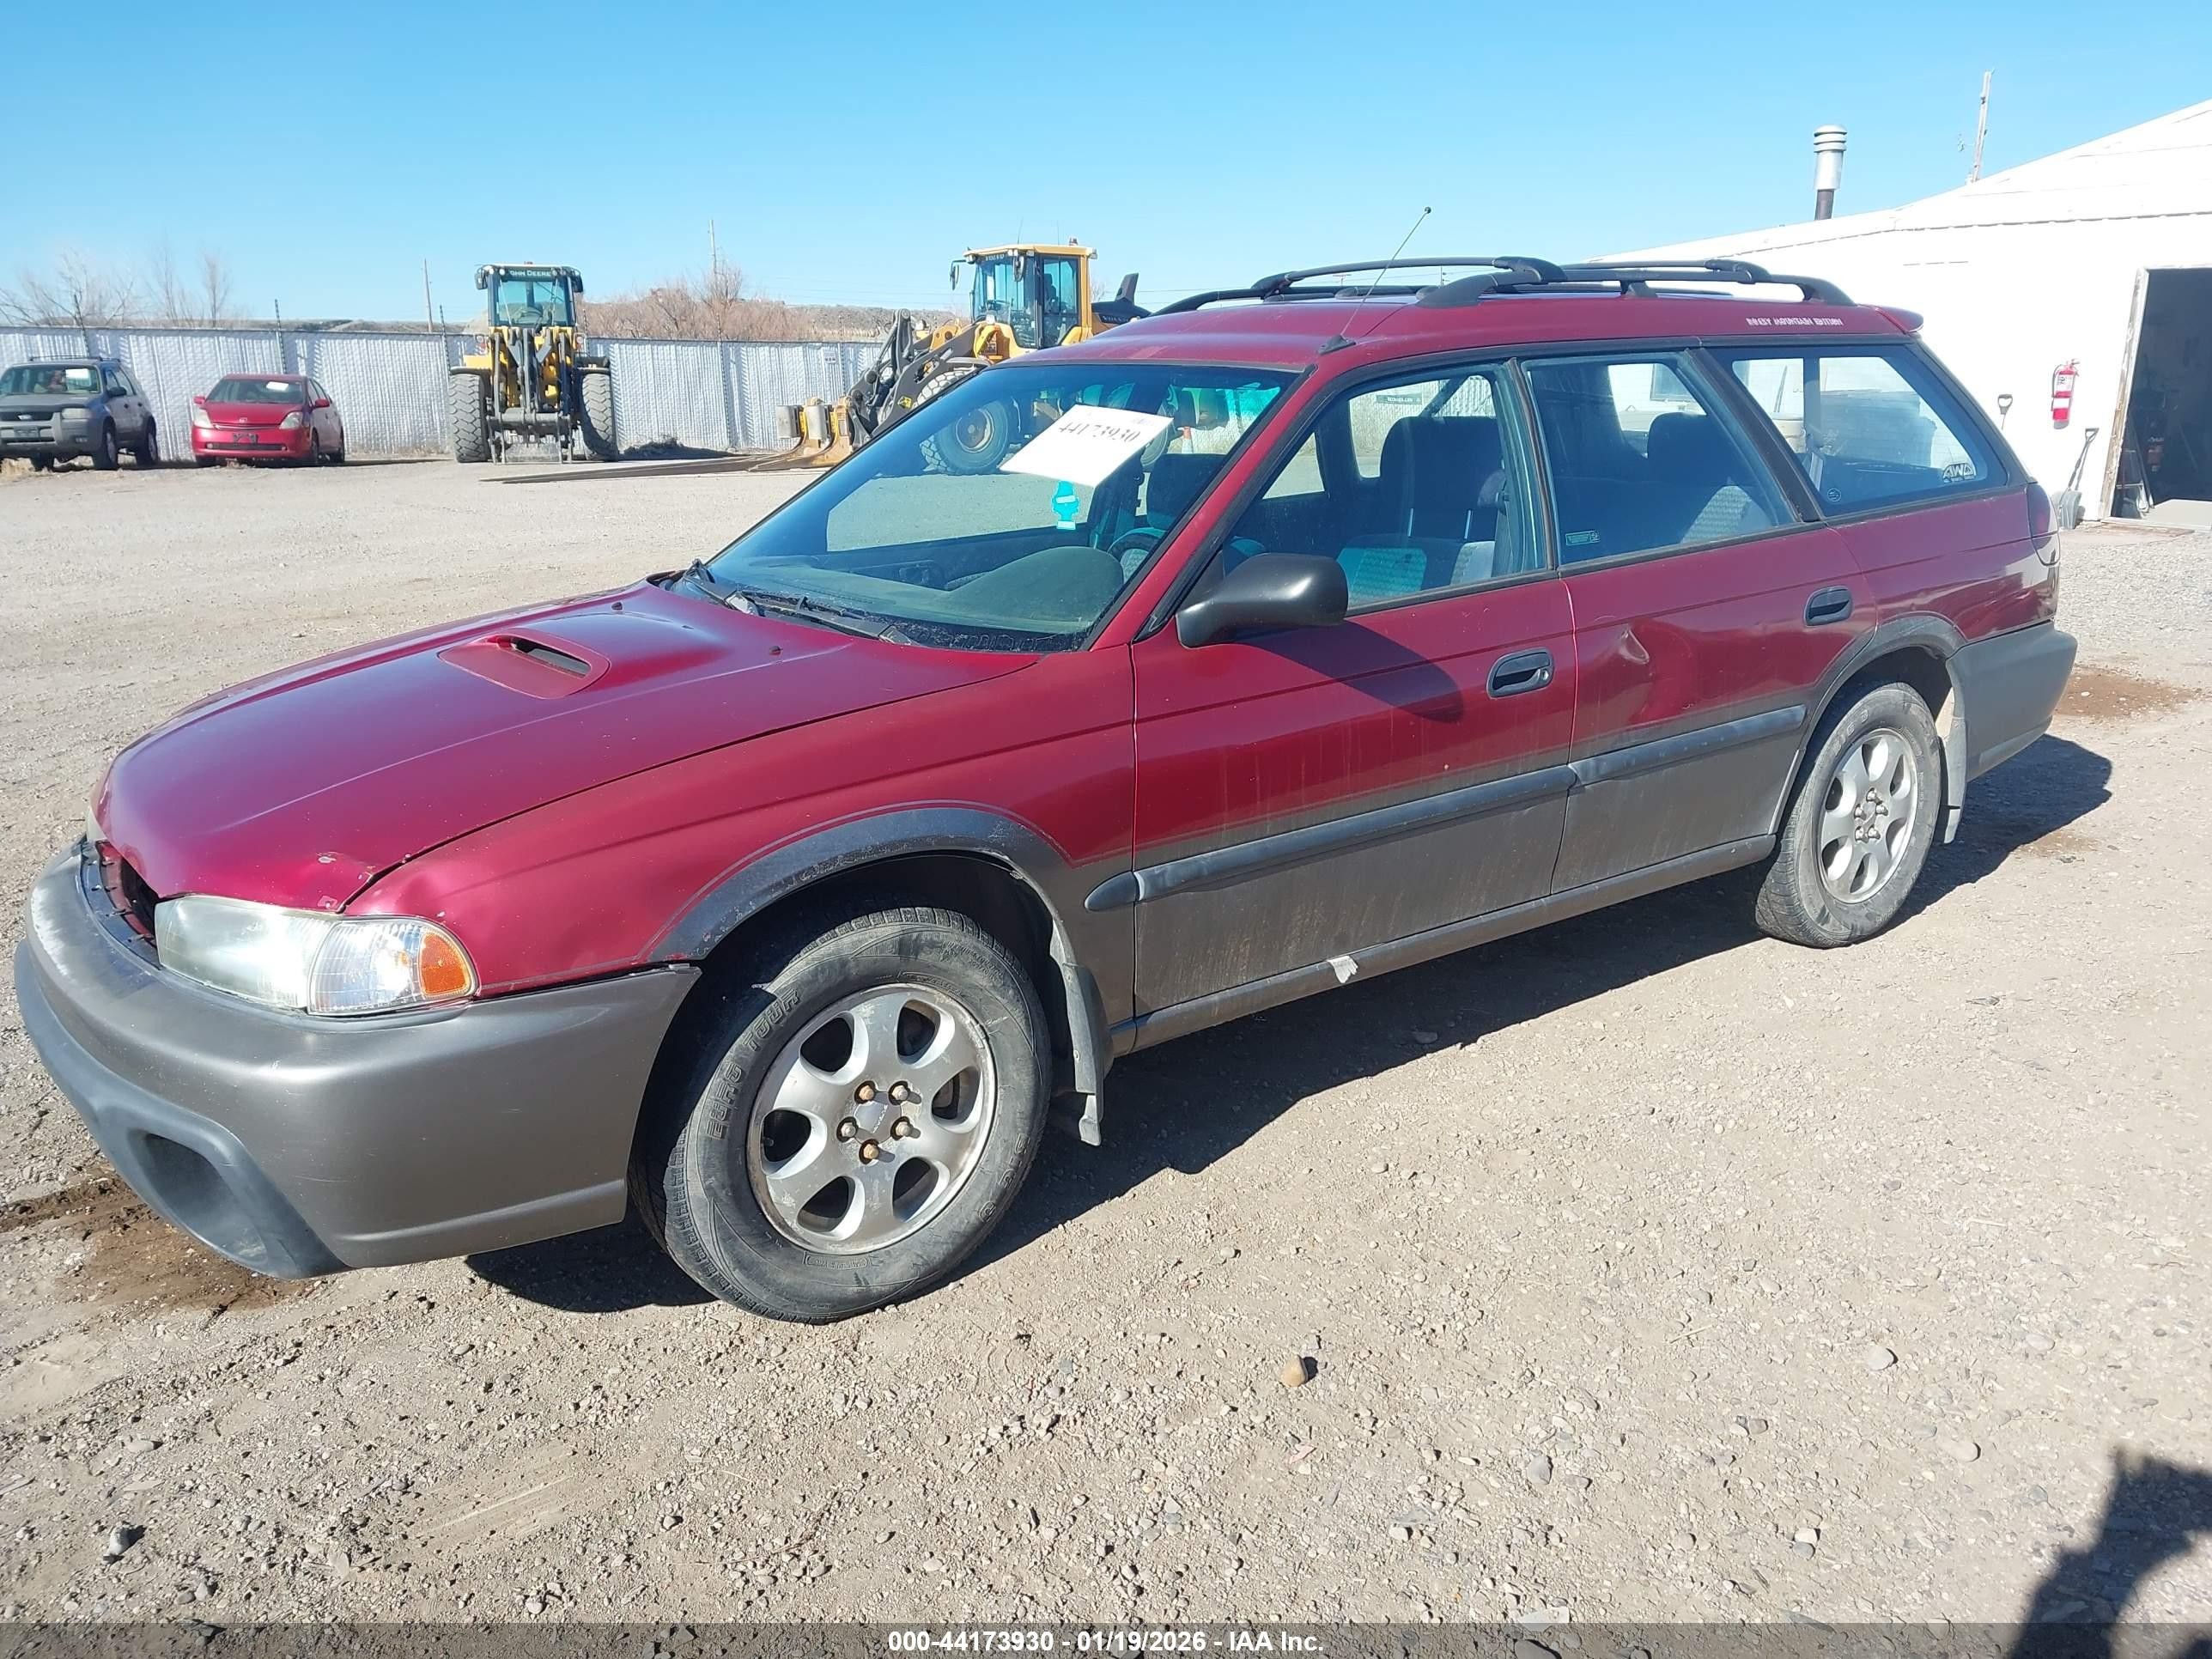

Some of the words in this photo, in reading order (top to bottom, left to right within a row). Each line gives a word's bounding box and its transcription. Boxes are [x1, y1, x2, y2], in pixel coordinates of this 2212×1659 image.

[1057, 422, 1141, 442] 44173930
[1942, 463, 1975, 483] AWD
[706, 1061, 744, 1140] EURO
[742, 988, 801, 1051] TOUR
